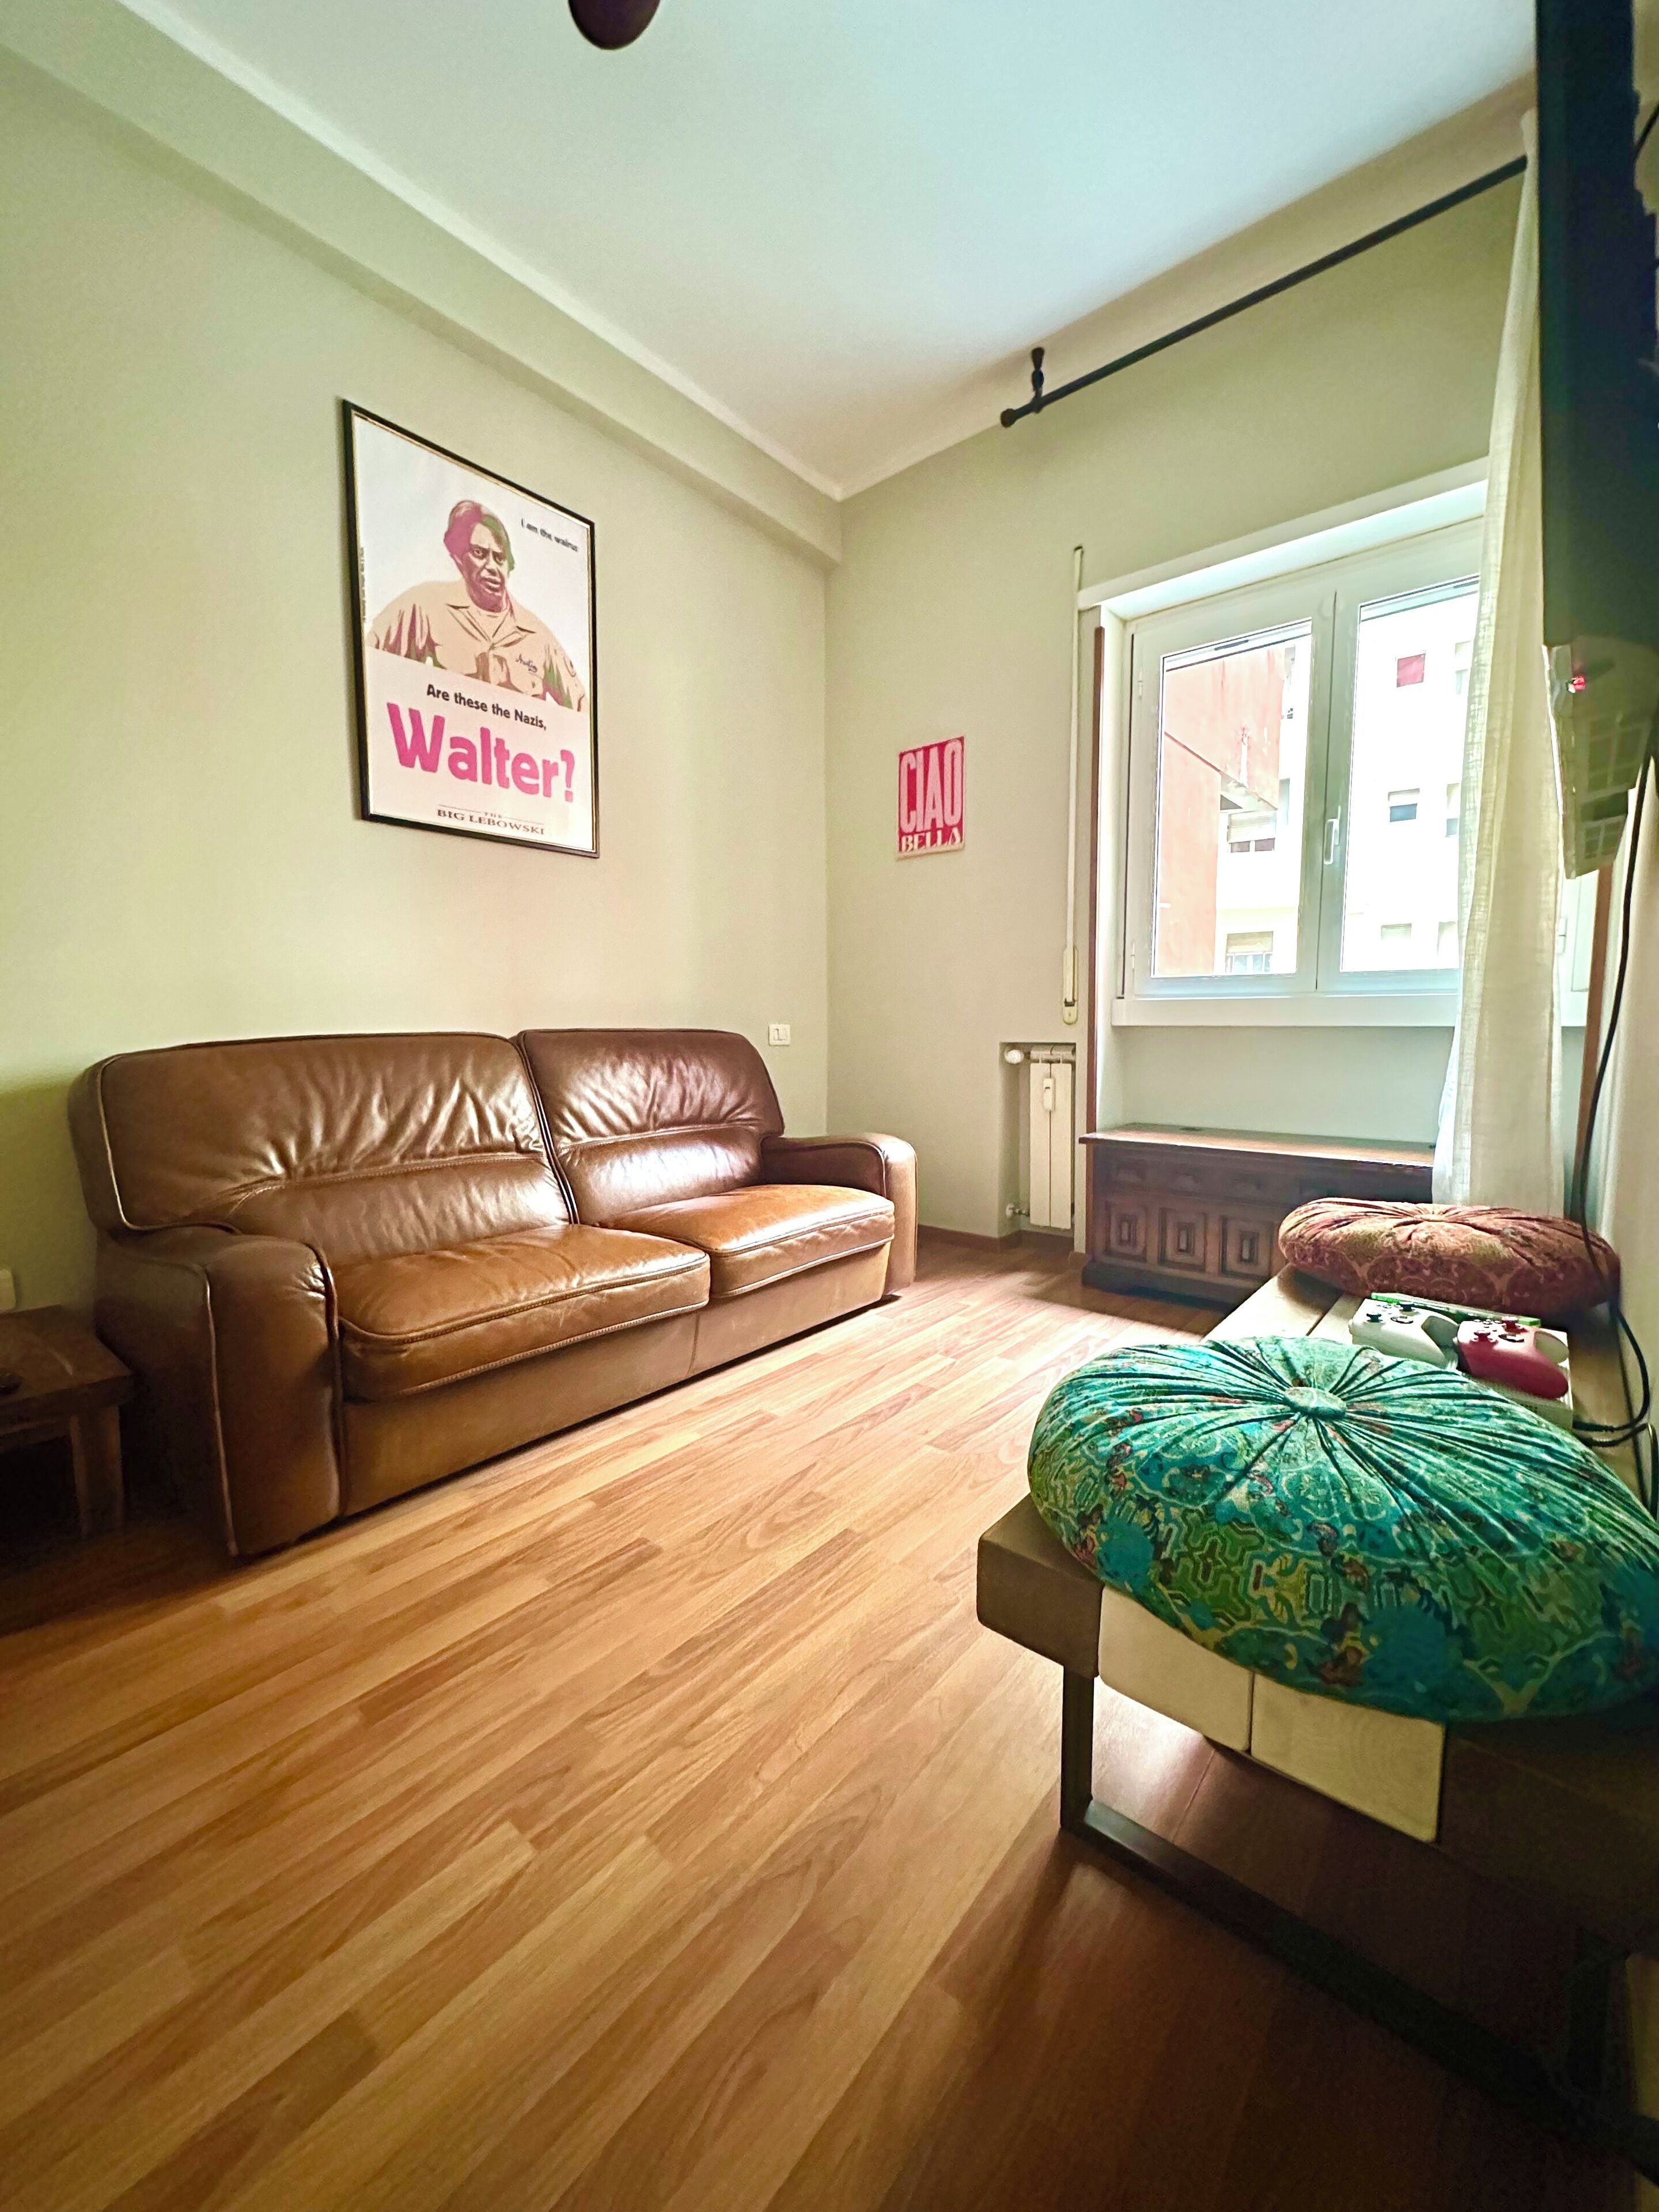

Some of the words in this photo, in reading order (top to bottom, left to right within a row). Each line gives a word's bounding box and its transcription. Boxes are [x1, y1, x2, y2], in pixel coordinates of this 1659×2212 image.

[540, 529, 553, 541] the
[426, 684, 450, 701] Are
[454, 692, 488, 712] these
[491, 703, 510, 718] the
[514, 709, 547, 731] Nazis,
[386, 702, 575, 803] Walter?
[900, 738, 963, 834] CIAO
[437, 809, 465, 821] BIG
[469, 815, 544, 835] LEBOWSKI
[901, 827, 963, 853] BELLA
